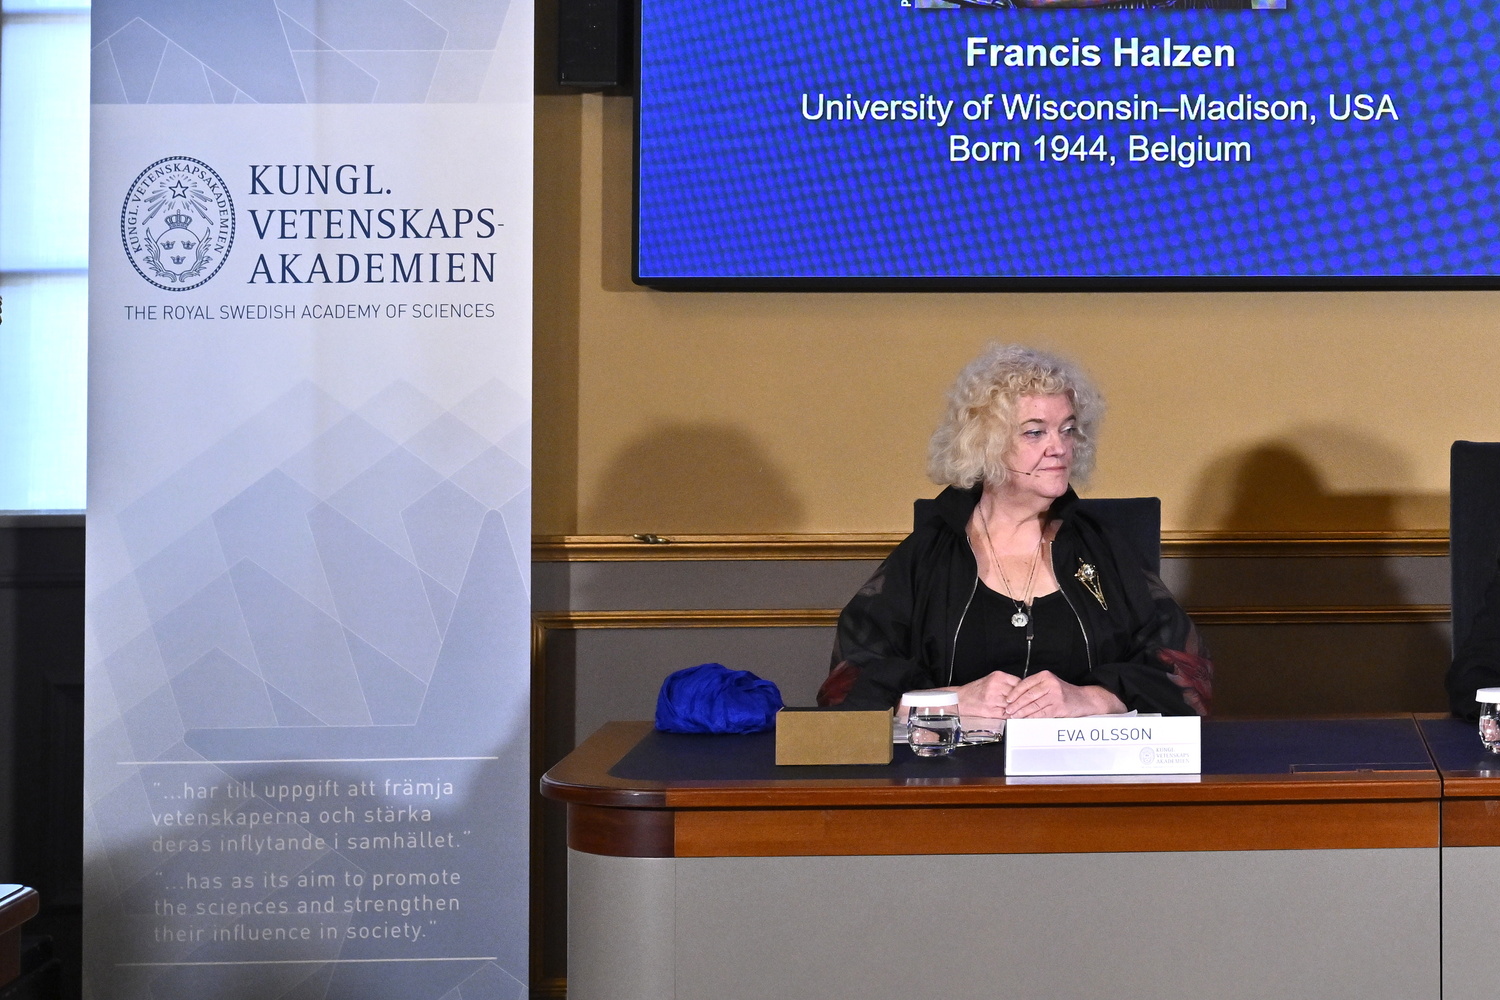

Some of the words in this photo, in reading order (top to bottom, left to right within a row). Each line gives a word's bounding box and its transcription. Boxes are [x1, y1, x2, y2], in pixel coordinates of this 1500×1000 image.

[967, 37, 1101, 66] Francis
[1115, 38, 1234, 66] Halzen
[803, 94, 953, 126] University
[963, 94, 993, 120] of
[1330, 94, 1398, 120] USA
[950, 135, 1019, 161] Born
[1035, 135, 1115, 166] 1944,
[1130, 135, 1250, 167] Belgium
[248, 164, 391, 195] KUNGL.
[131, 163, 230, 255] VETENSKAPSAKADEMIEN
[128, 203, 143, 254] KUNGL.
[247, 208, 504, 239] VETENSKAPS-
[247, 253, 497, 284] AKADEMIEN
[124, 306, 157, 320] THE
[164, 306, 215, 320] ROYAL
[220, 305, 295, 319] SWEDISH
[301, 304, 380, 319] ACADEMY
[386, 304, 407, 318] OF
[412, 303, 494, 318] SCIENCES
[1058, 730, 1085, 742] EVA
[1090, 728, 1151, 741] OLSSON
[226, 781, 255, 799] till
[265, 781, 340, 801] uppgift
[348, 781, 376, 797] att
[384, 779, 453, 800] främja
[152, 809, 310, 829] vetenskaperna
[319, 808, 355, 824] och
[364, 806, 432, 823] stärka
[152, 836, 211, 853] deras
[220, 833, 325, 855] inflytande
[334, 834, 339, 850] i
[231, 874, 254, 888] as
[264, 872, 289, 888] its
[297, 871, 335, 888] aim
[344, 870, 363, 888] to
[373, 870, 461, 890] promote
[155, 900, 187, 917] the
[195, 899, 288, 915] sciences
[297, 898, 334, 914] and
[344, 896, 460, 917] strengthen
[155, 926, 204, 943] their
[213, 924, 311, 941] influence
[320, 924, 338, 939] in
